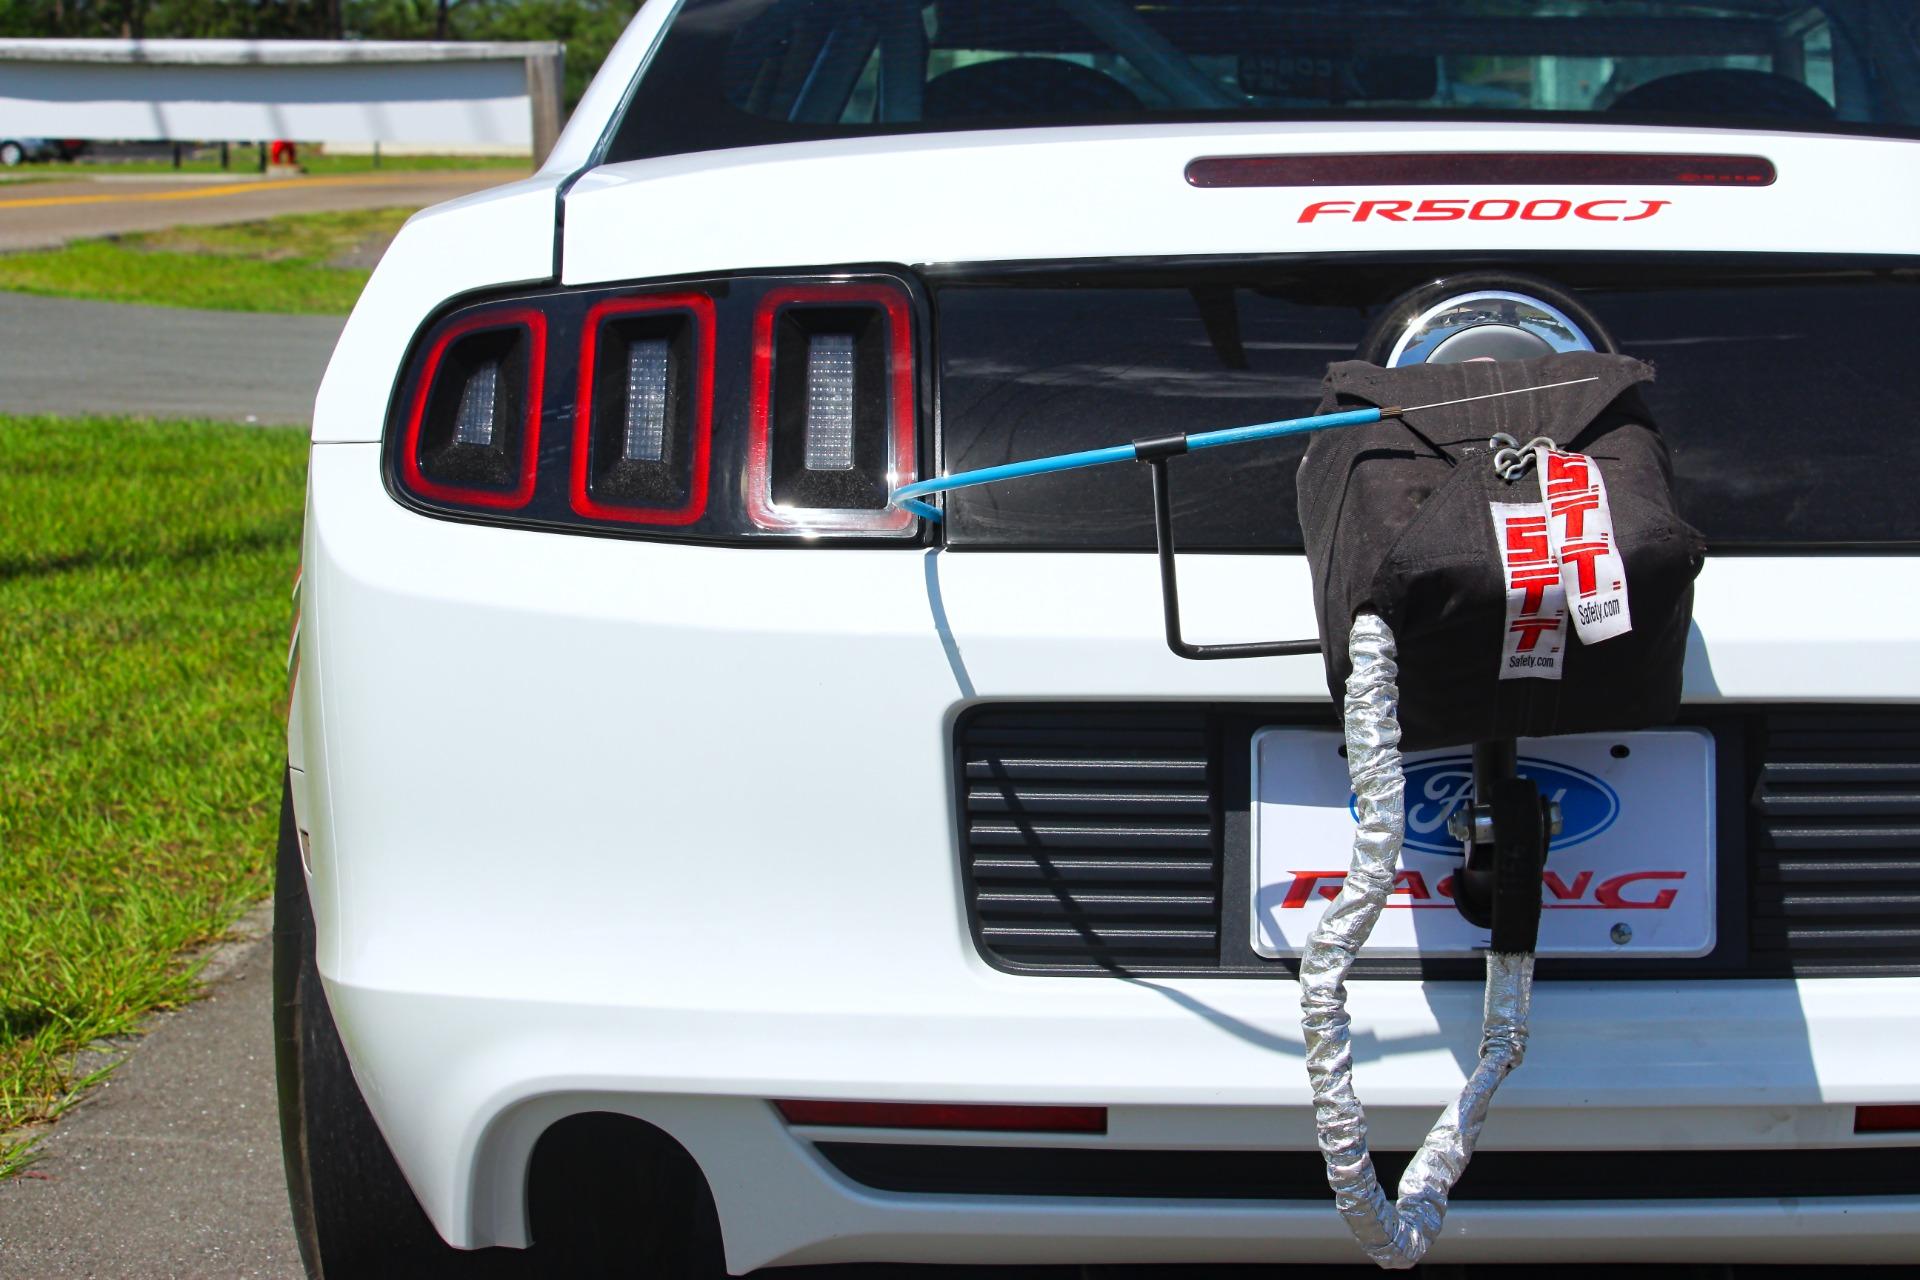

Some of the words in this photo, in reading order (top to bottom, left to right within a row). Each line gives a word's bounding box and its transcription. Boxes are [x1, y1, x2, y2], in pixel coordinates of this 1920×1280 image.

[1297, 199, 1671, 223] FR500CJ
[1578, 598, 1620, 626] Safety.com
[1509, 655, 1554, 668] Safety.com
